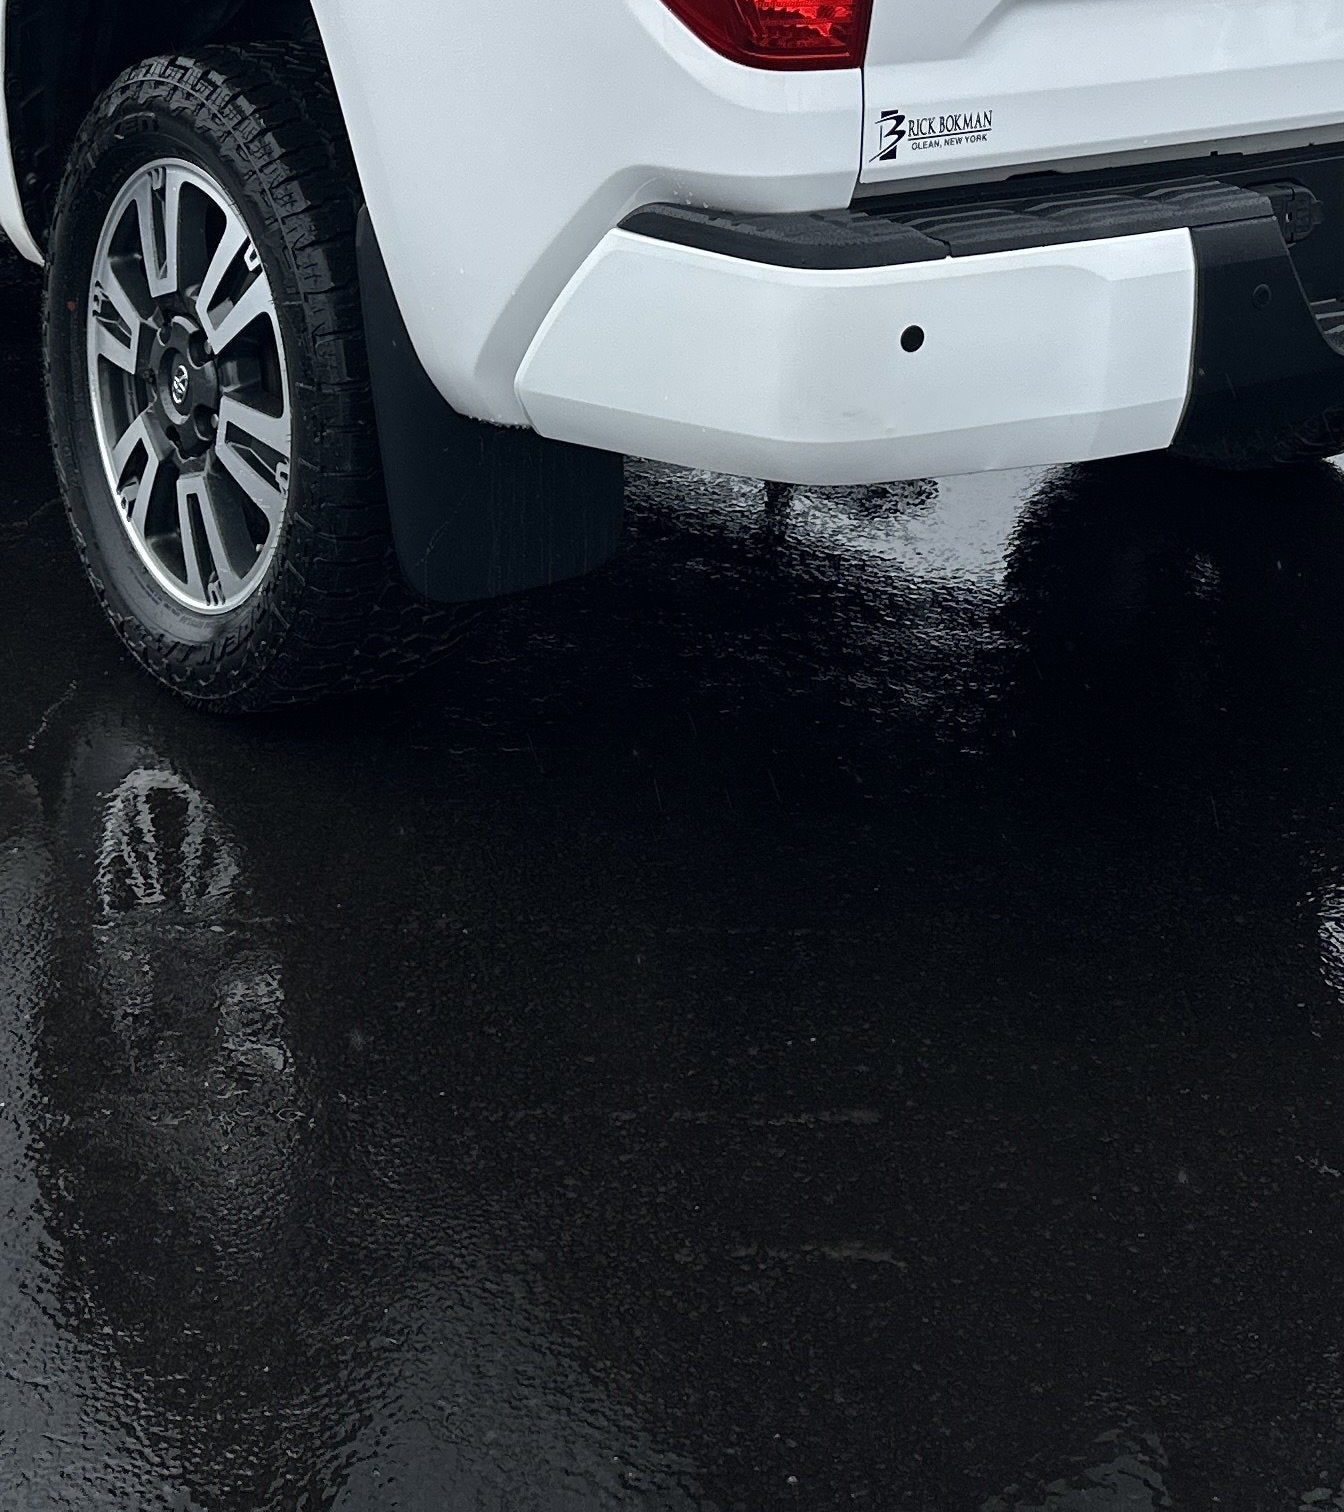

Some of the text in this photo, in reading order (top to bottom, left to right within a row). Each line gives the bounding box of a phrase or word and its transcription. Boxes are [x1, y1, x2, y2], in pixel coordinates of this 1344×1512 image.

[907, 109, 993, 138] RICK BOKMAN
[943, 137, 964, 147] NEW
[964, 133, 988, 144] YORK
